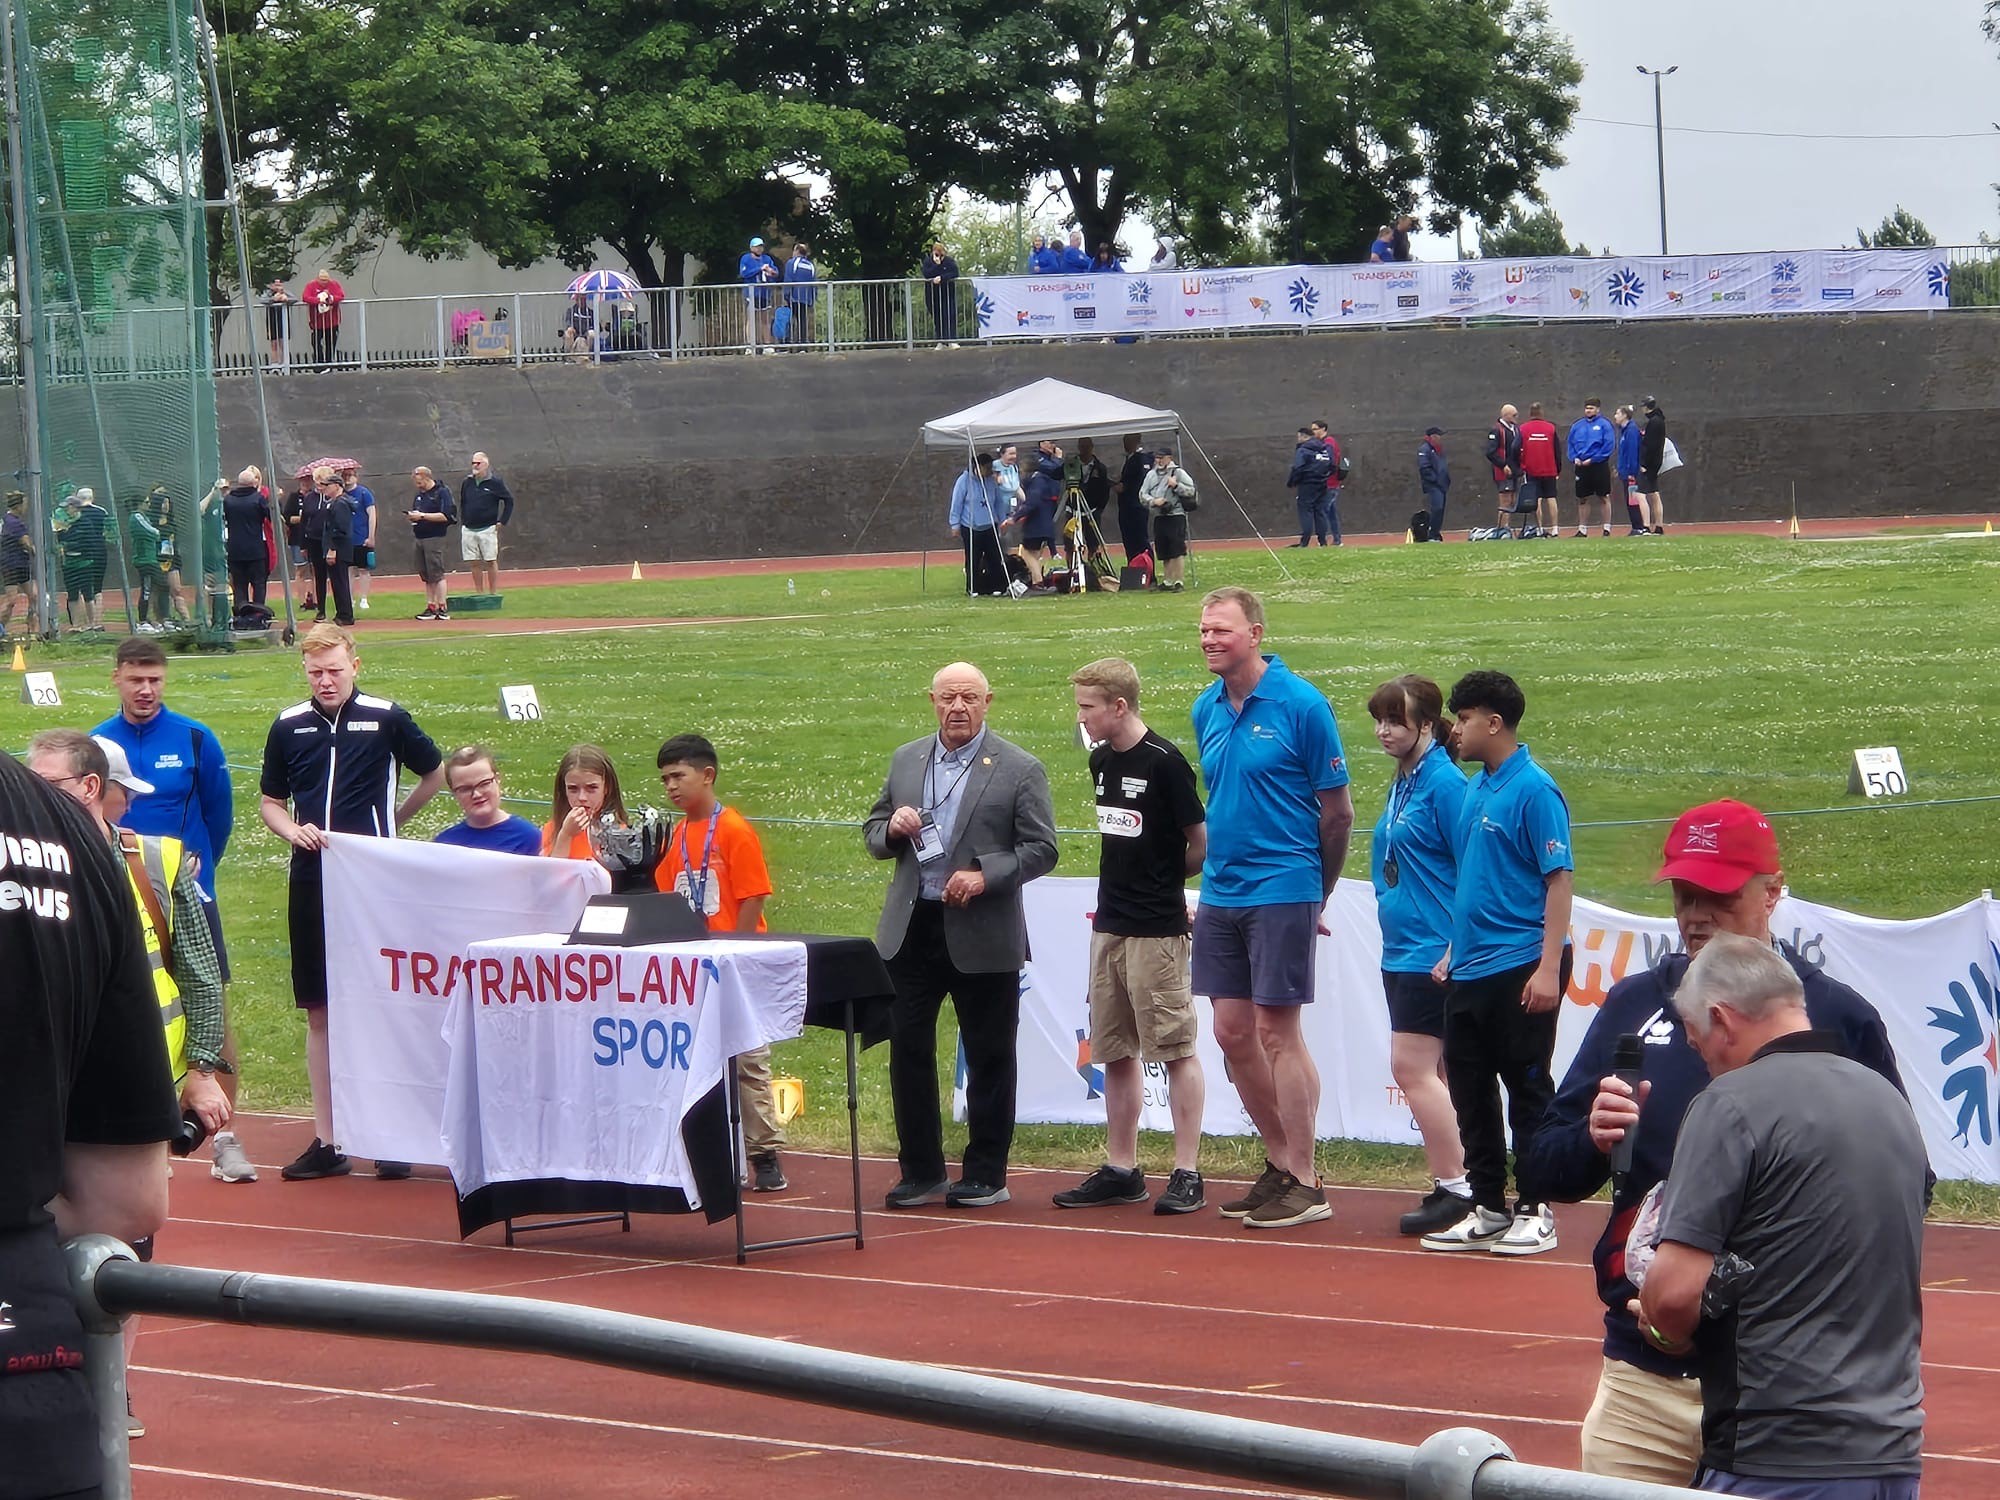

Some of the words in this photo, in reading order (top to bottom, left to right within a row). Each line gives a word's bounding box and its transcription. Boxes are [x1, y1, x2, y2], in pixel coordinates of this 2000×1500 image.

[1203, 275, 1253, 285] Westfield
[1352, 271, 1419, 281] TRANSPLANT
[1027, 282, 1095, 293] TRANSPLANT
[1386, 281, 1419, 290] SPORT
[34, 687, 58, 705] 20
[511, 702, 539, 721] 30
[1867, 771, 1904, 797] 50
[1106, 813, 1133, 827] Books
